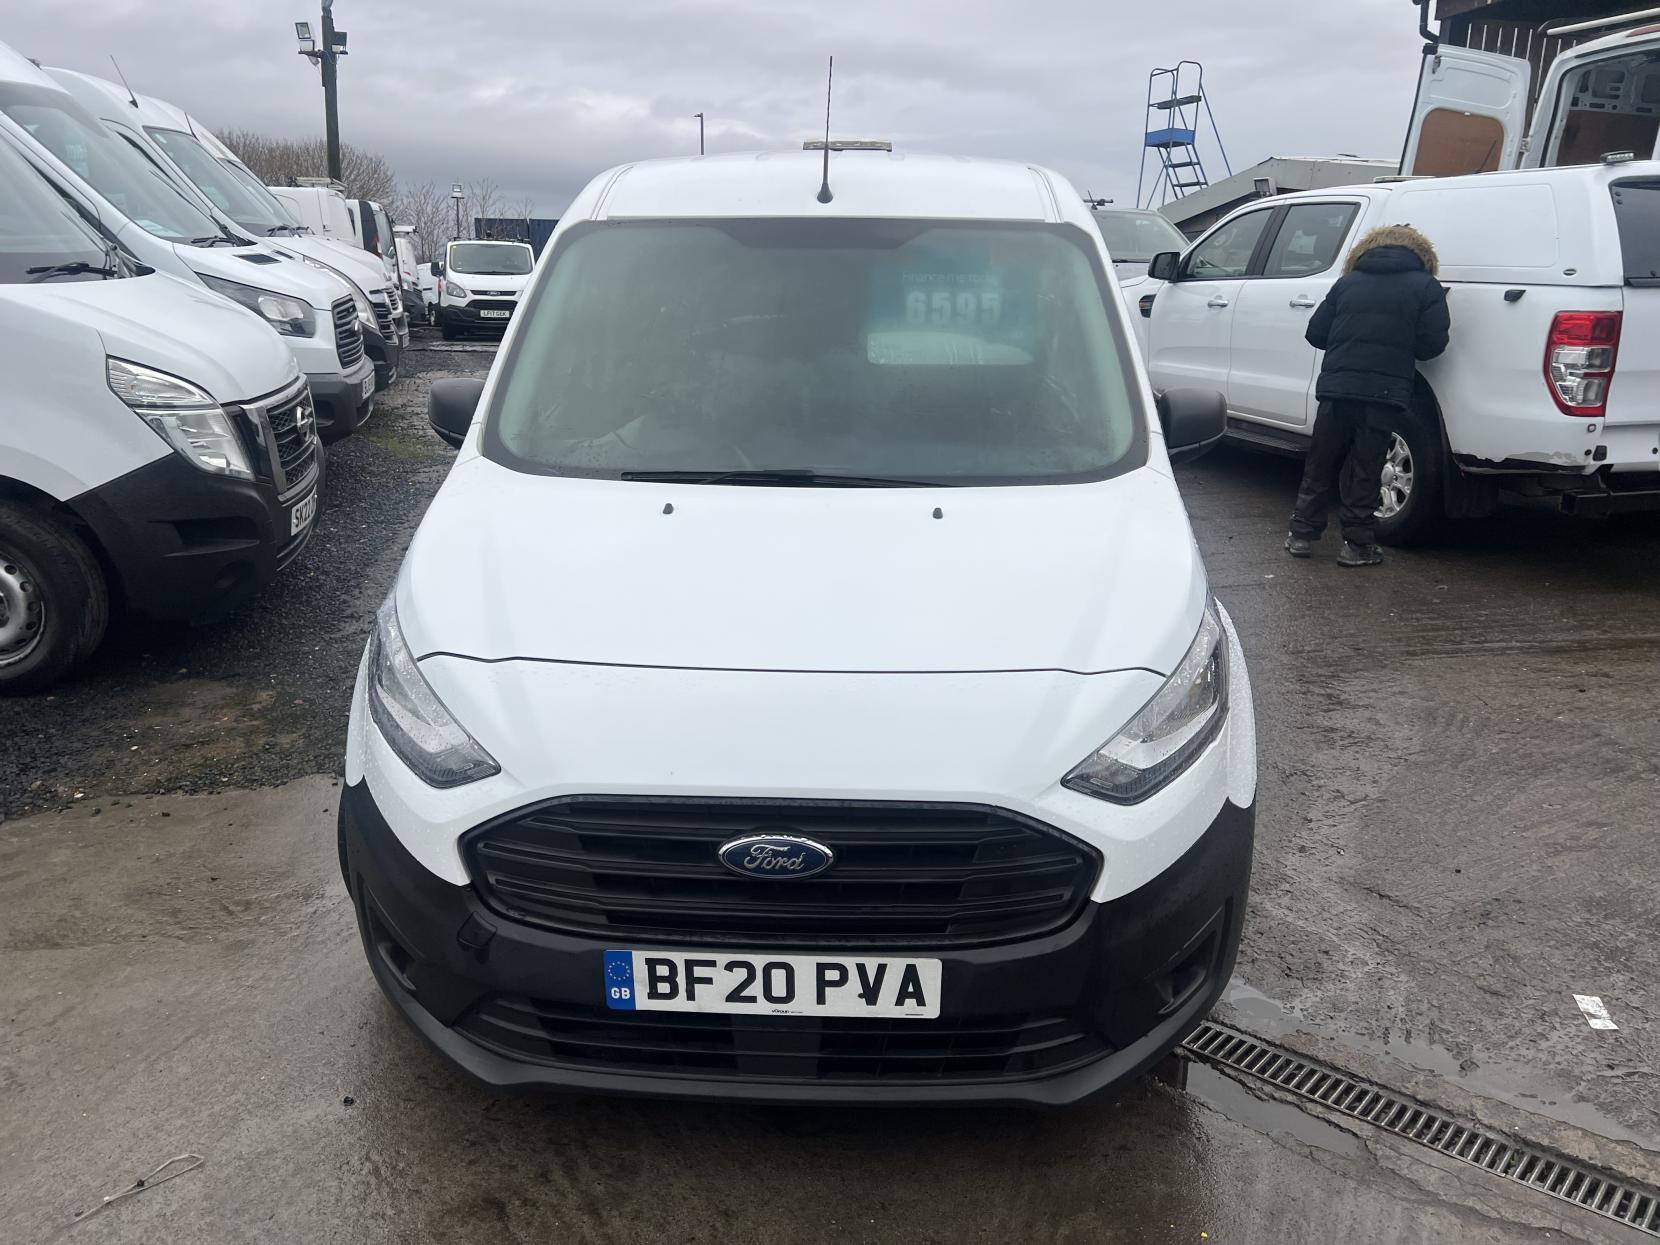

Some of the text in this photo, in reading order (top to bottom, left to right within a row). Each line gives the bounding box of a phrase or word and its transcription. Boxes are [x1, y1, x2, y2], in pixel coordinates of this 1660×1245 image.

[906, 291, 1000, 323] 6595
[743, 844, 807, 869] Ford
[611, 987, 631, 999] GB
[645, 957, 926, 1007] BF20 PVA
